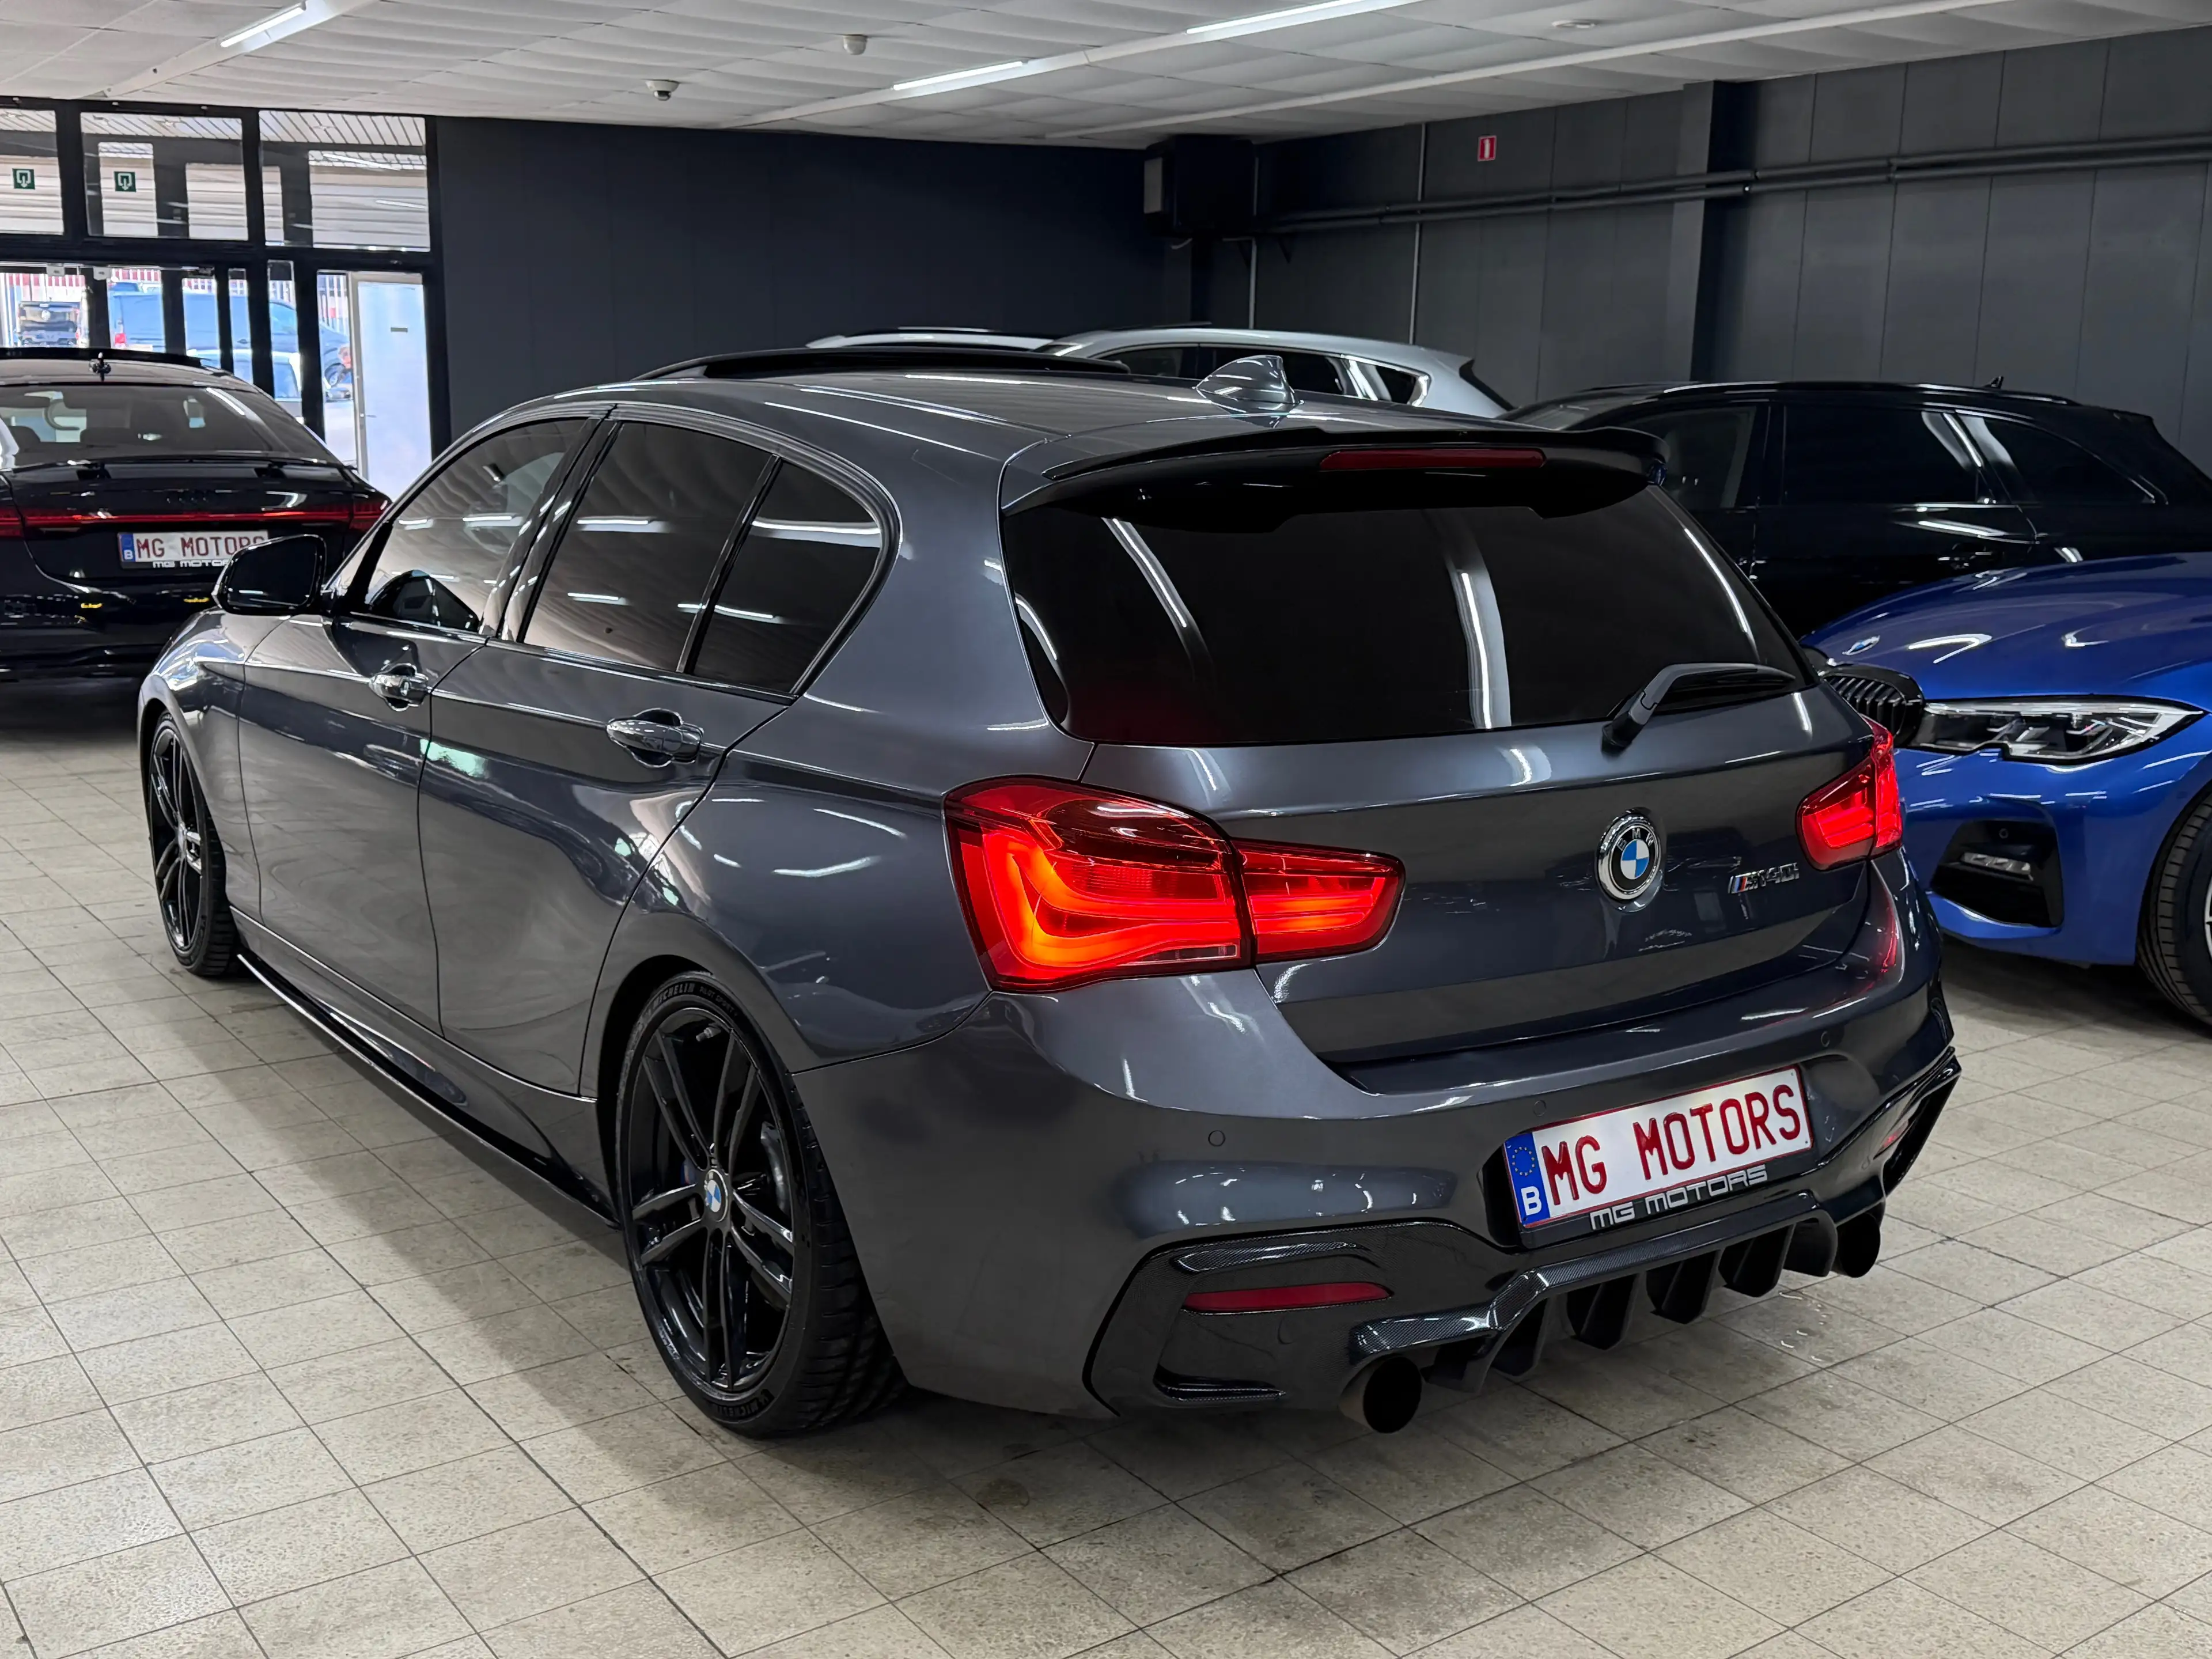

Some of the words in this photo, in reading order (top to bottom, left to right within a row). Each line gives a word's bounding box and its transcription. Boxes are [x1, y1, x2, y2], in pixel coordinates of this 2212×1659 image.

[124, 550, 133, 559] B
[136, 538, 165, 558] MG
[1616, 827, 1655, 851] BMW
[653, 983, 696, 1008] MICHELIN
[1541, 1135, 1607, 1205] MG
[1633, 1084, 1801, 1180] MOTORS
[1521, 1185, 1542, 1216] B
[1590, 1206, 1635, 1230] MG
[1645, 1165, 1768, 1216] MOTORS
